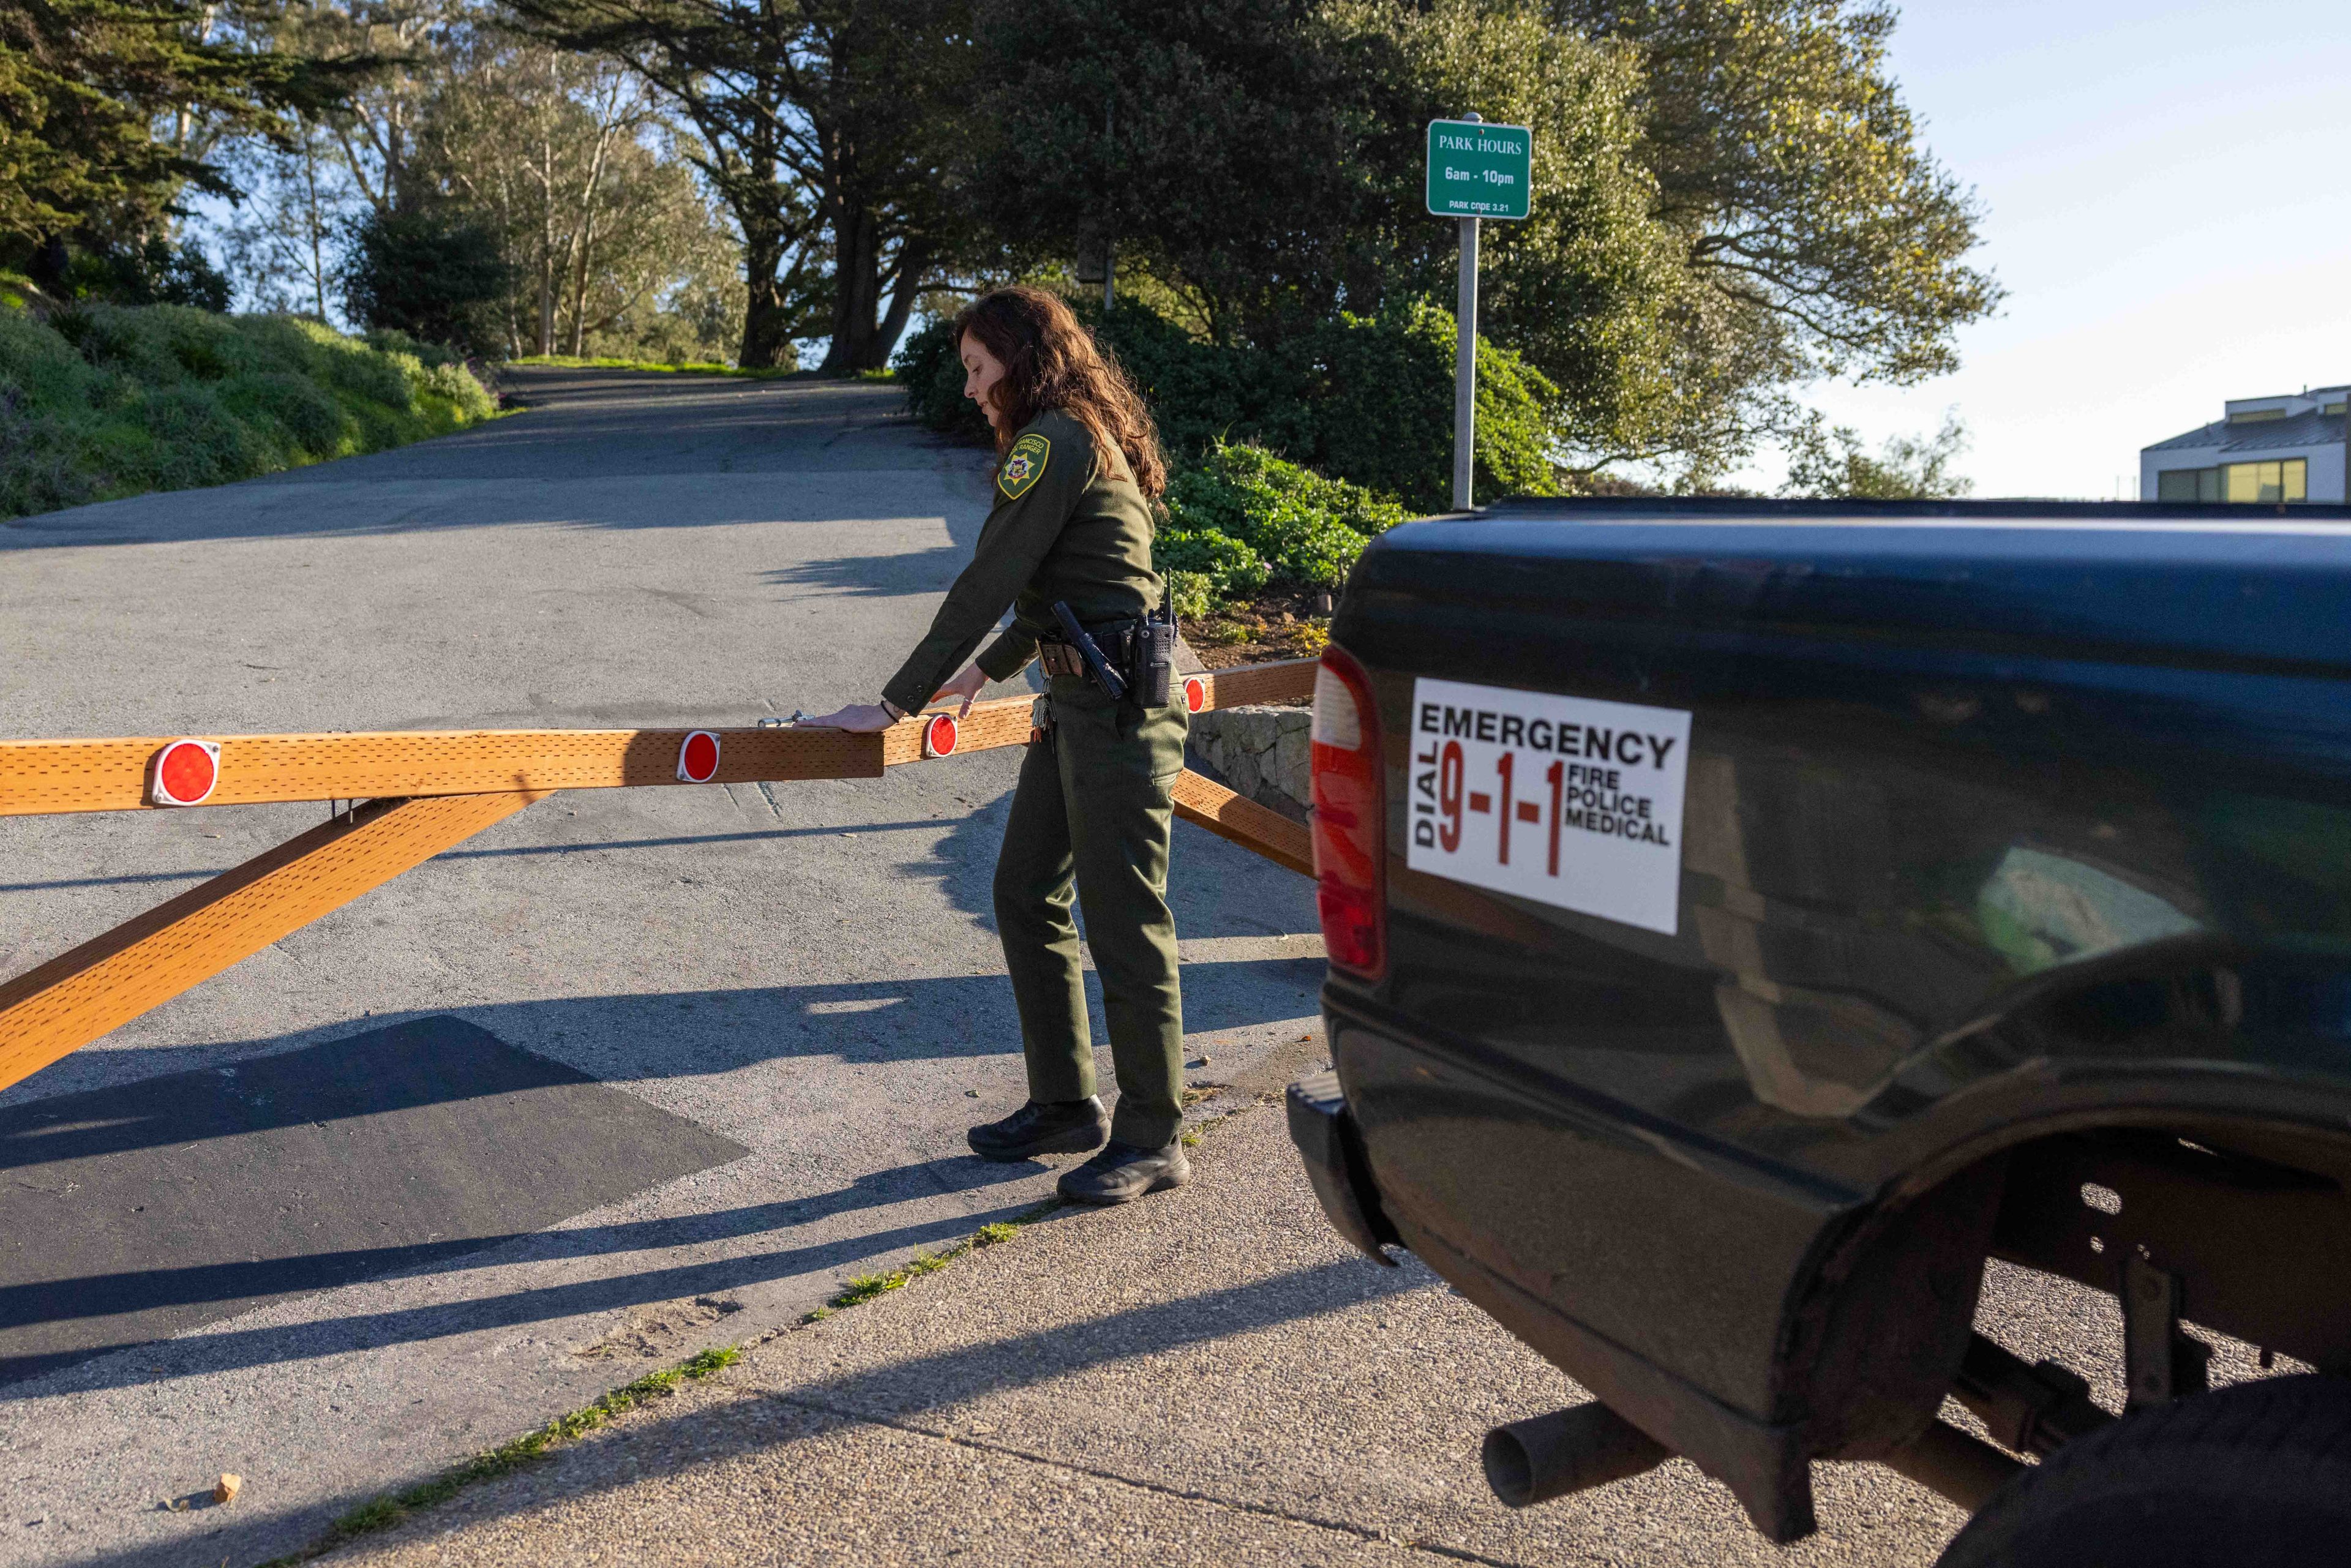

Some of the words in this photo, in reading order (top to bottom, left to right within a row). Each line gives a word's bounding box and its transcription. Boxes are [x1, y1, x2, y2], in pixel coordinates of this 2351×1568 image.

[1439, 135, 1474, 151] PARK
[1478, 139, 1521, 155] HOURS
[1445, 167, 1469, 181] 6am
[1483, 170, 1514, 186] 10pm
[1449, 200, 1469, 209] PARK
[1471, 202, 1490, 211] CODE
[1019, 444, 1041, 454] RANGER
[1420, 703, 1676, 770] EMERGENCY
[1567, 764, 1621, 790] FIRE
[1415, 741, 1438, 848] DIAL
[1439, 741, 1564, 877] 9-1-1
[1567, 786, 1651, 819] POLICE
[1565, 808, 1670, 846] MEDICAL
